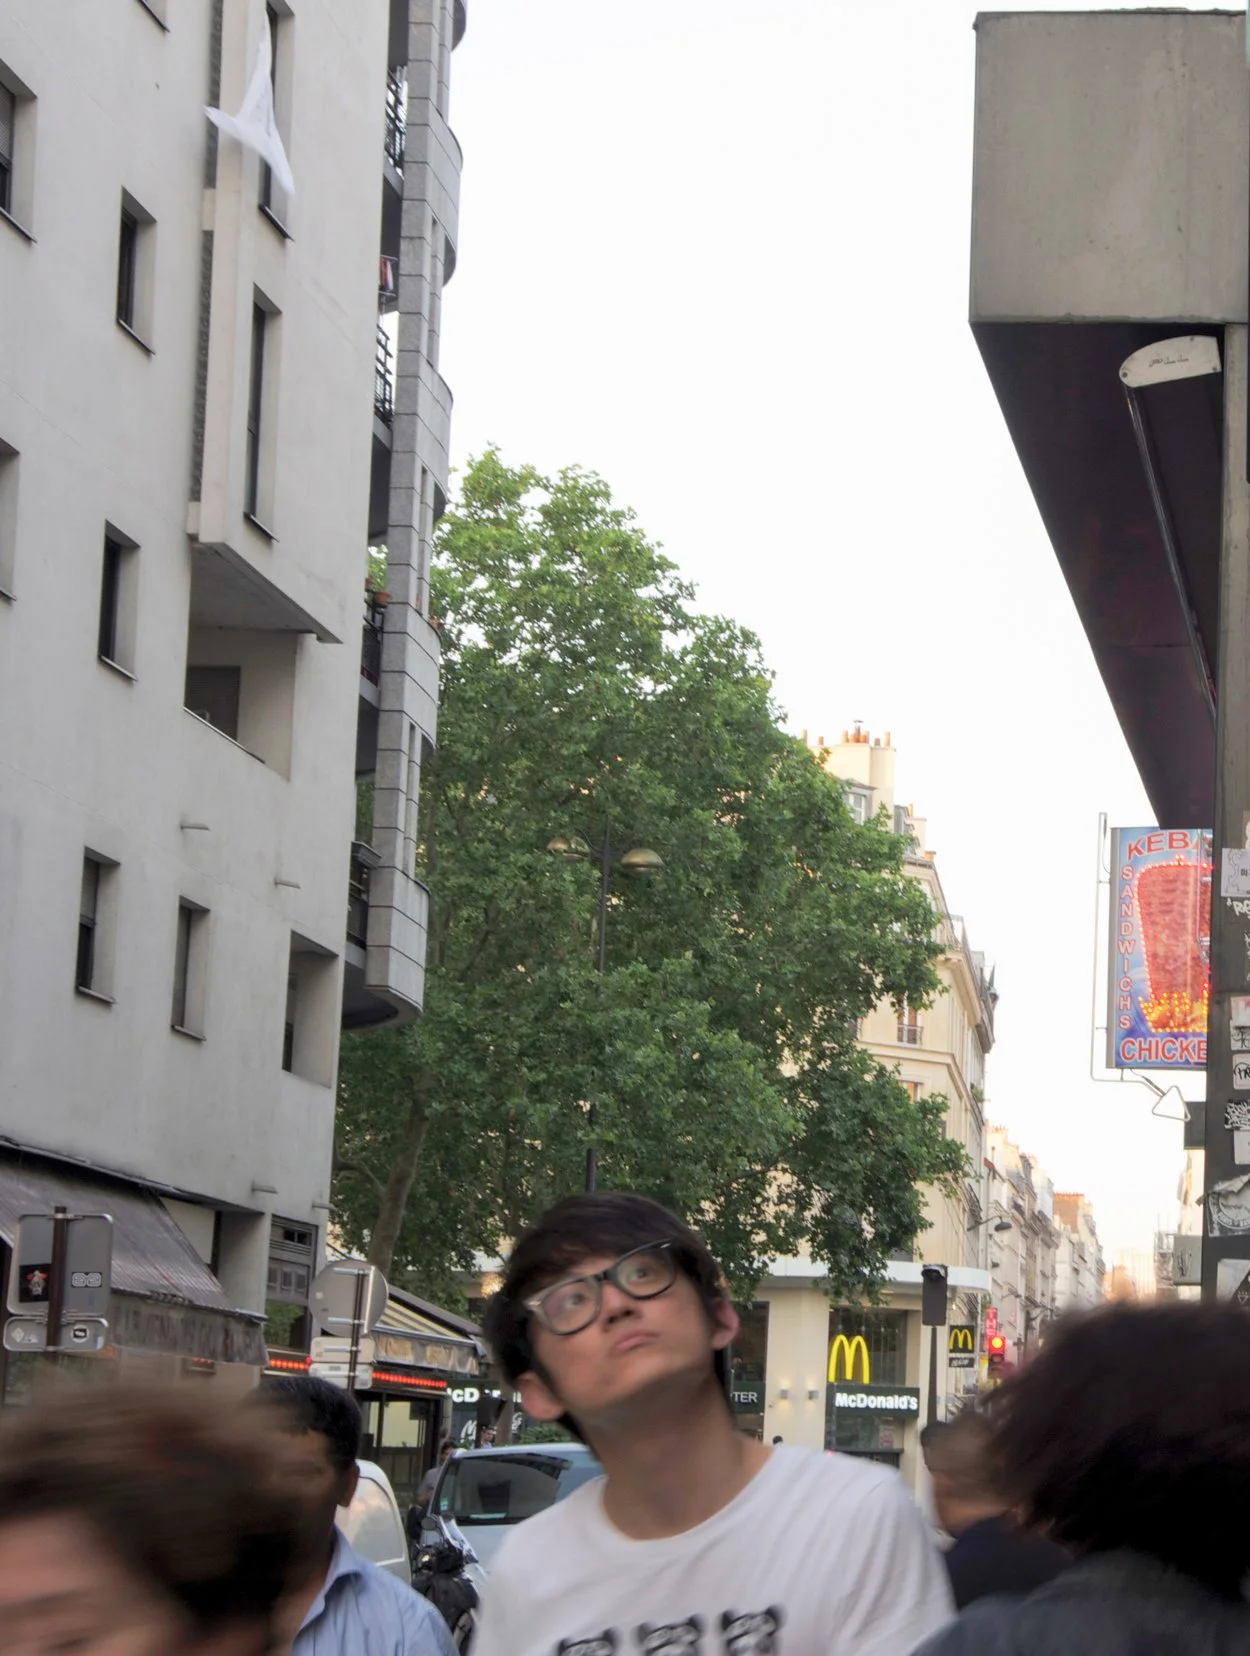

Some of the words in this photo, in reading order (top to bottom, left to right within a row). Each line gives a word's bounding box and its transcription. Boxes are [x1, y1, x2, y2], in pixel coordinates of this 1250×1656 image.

[1127, 831, 1198, 861] KEB
[1118, 866, 1136, 1030] SANDWICHS
[731, 1391, 758, 1403] TER
[836, 1392, 918, 1410] McDonald's
